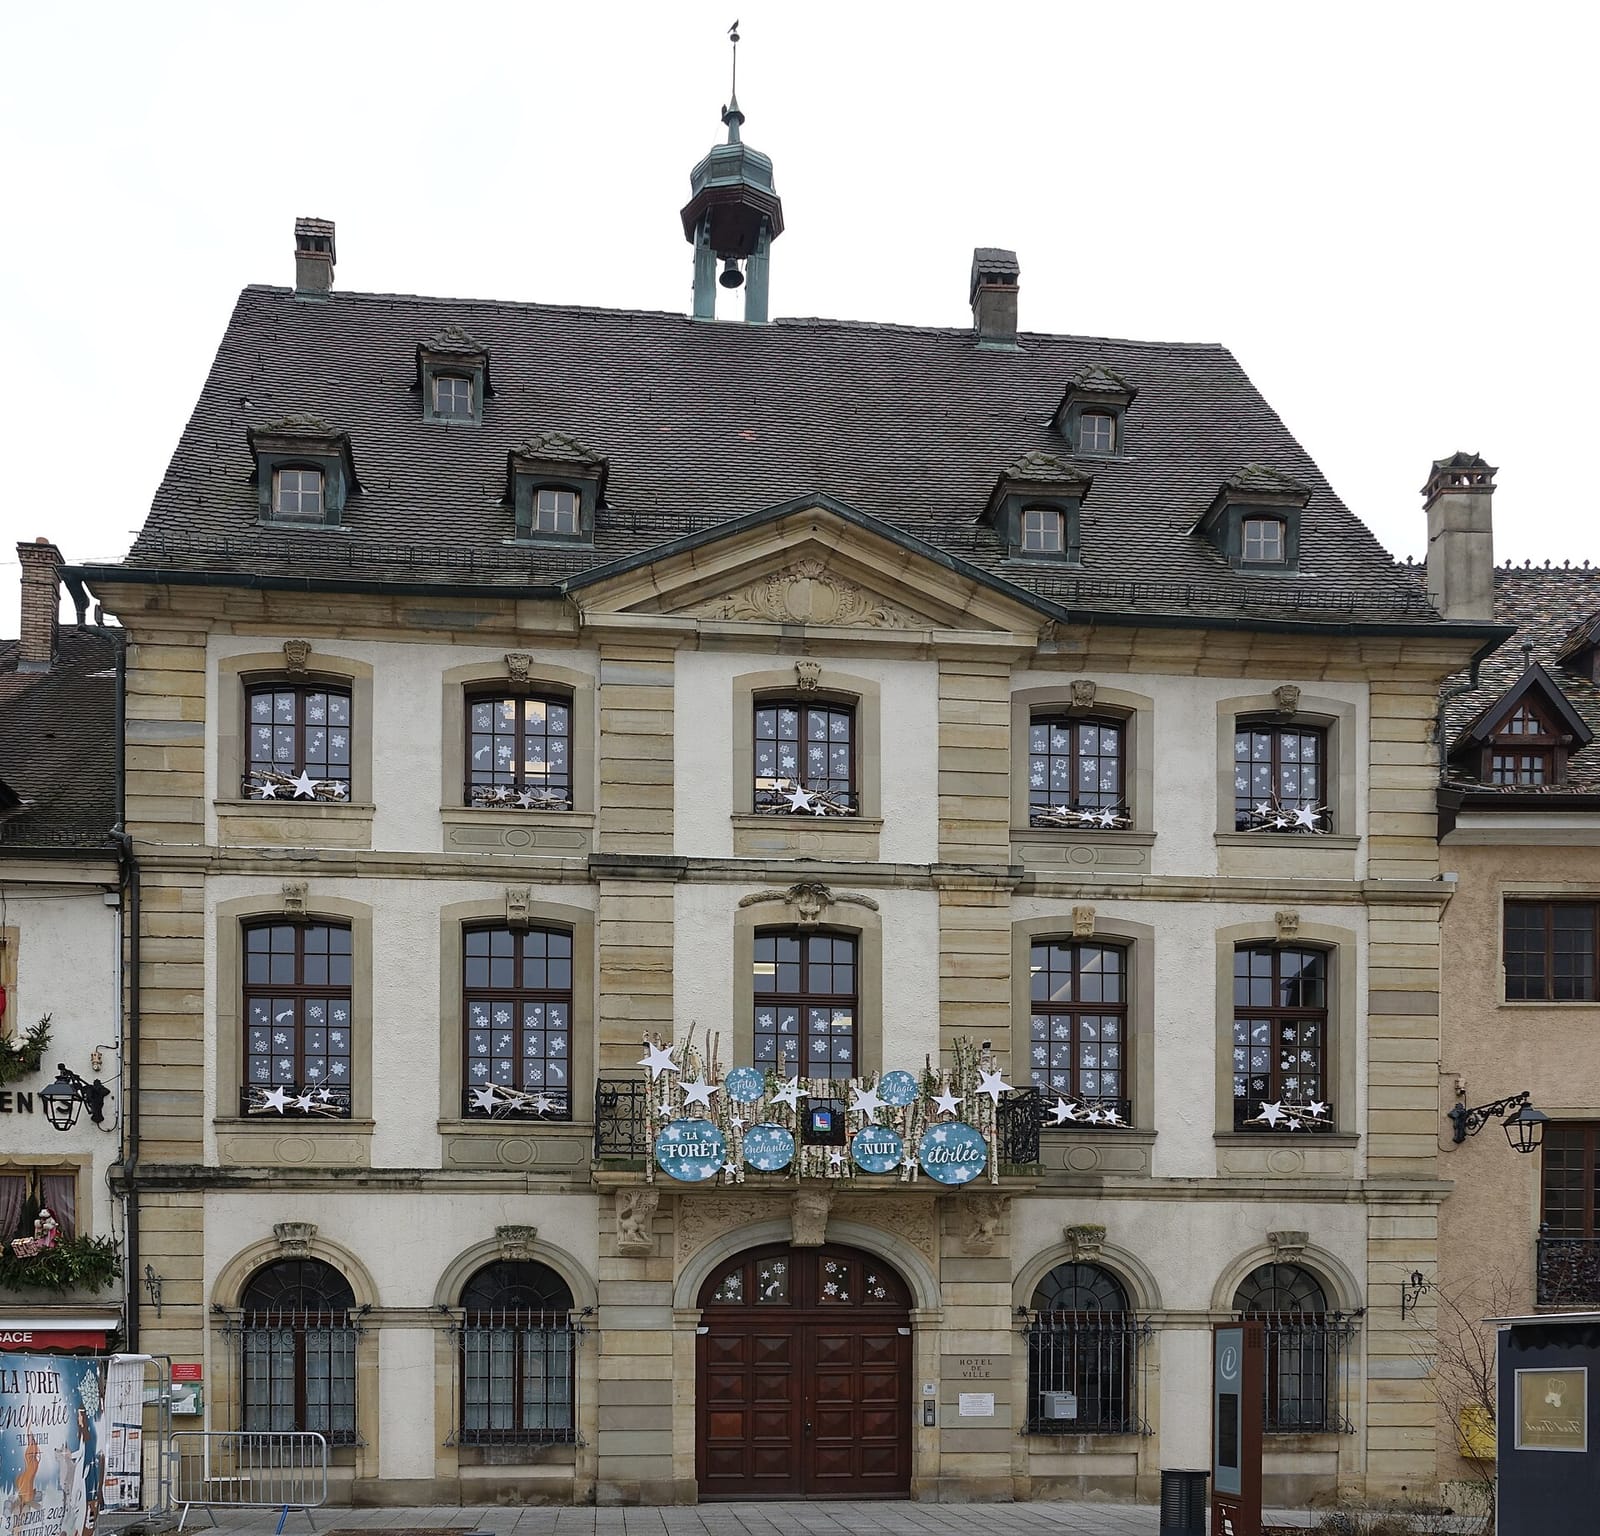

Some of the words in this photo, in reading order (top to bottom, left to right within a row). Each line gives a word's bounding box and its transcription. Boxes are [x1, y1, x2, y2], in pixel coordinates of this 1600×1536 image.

[881, 1082, 915, 1095] Magie
[682, 1131, 698, 1141] LA
[661, 1140, 721, 1159] FORÊT
[859, 1142, 897, 1155] NUIT
[927, 1144, 979, 1163] étoilée
[0, 1332, 33, 1342] ACE
[1, 1369, 20, 1394] LA
[24, 1365, 60, 1394] FORÊT
